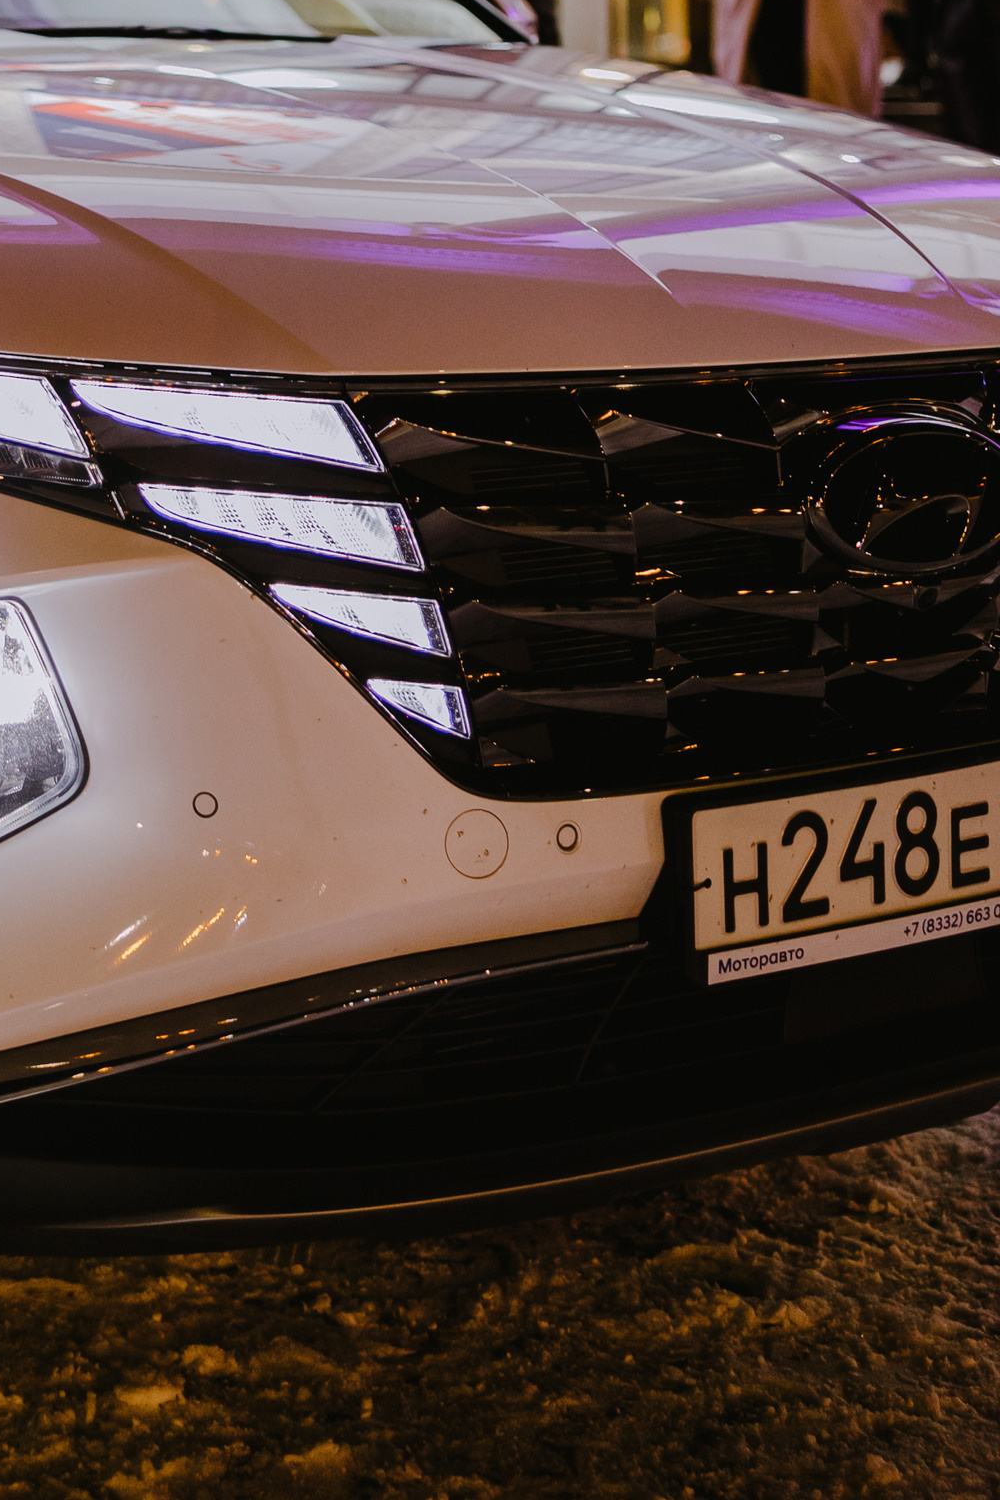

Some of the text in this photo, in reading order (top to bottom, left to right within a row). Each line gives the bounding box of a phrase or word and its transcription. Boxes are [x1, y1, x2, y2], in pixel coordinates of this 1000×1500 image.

[904, 921, 919, 937] +7
[922, 911, 963, 936] (8332)
[966, 906, 990, 925] 663
[718, 947, 805, 975] Моторавто
